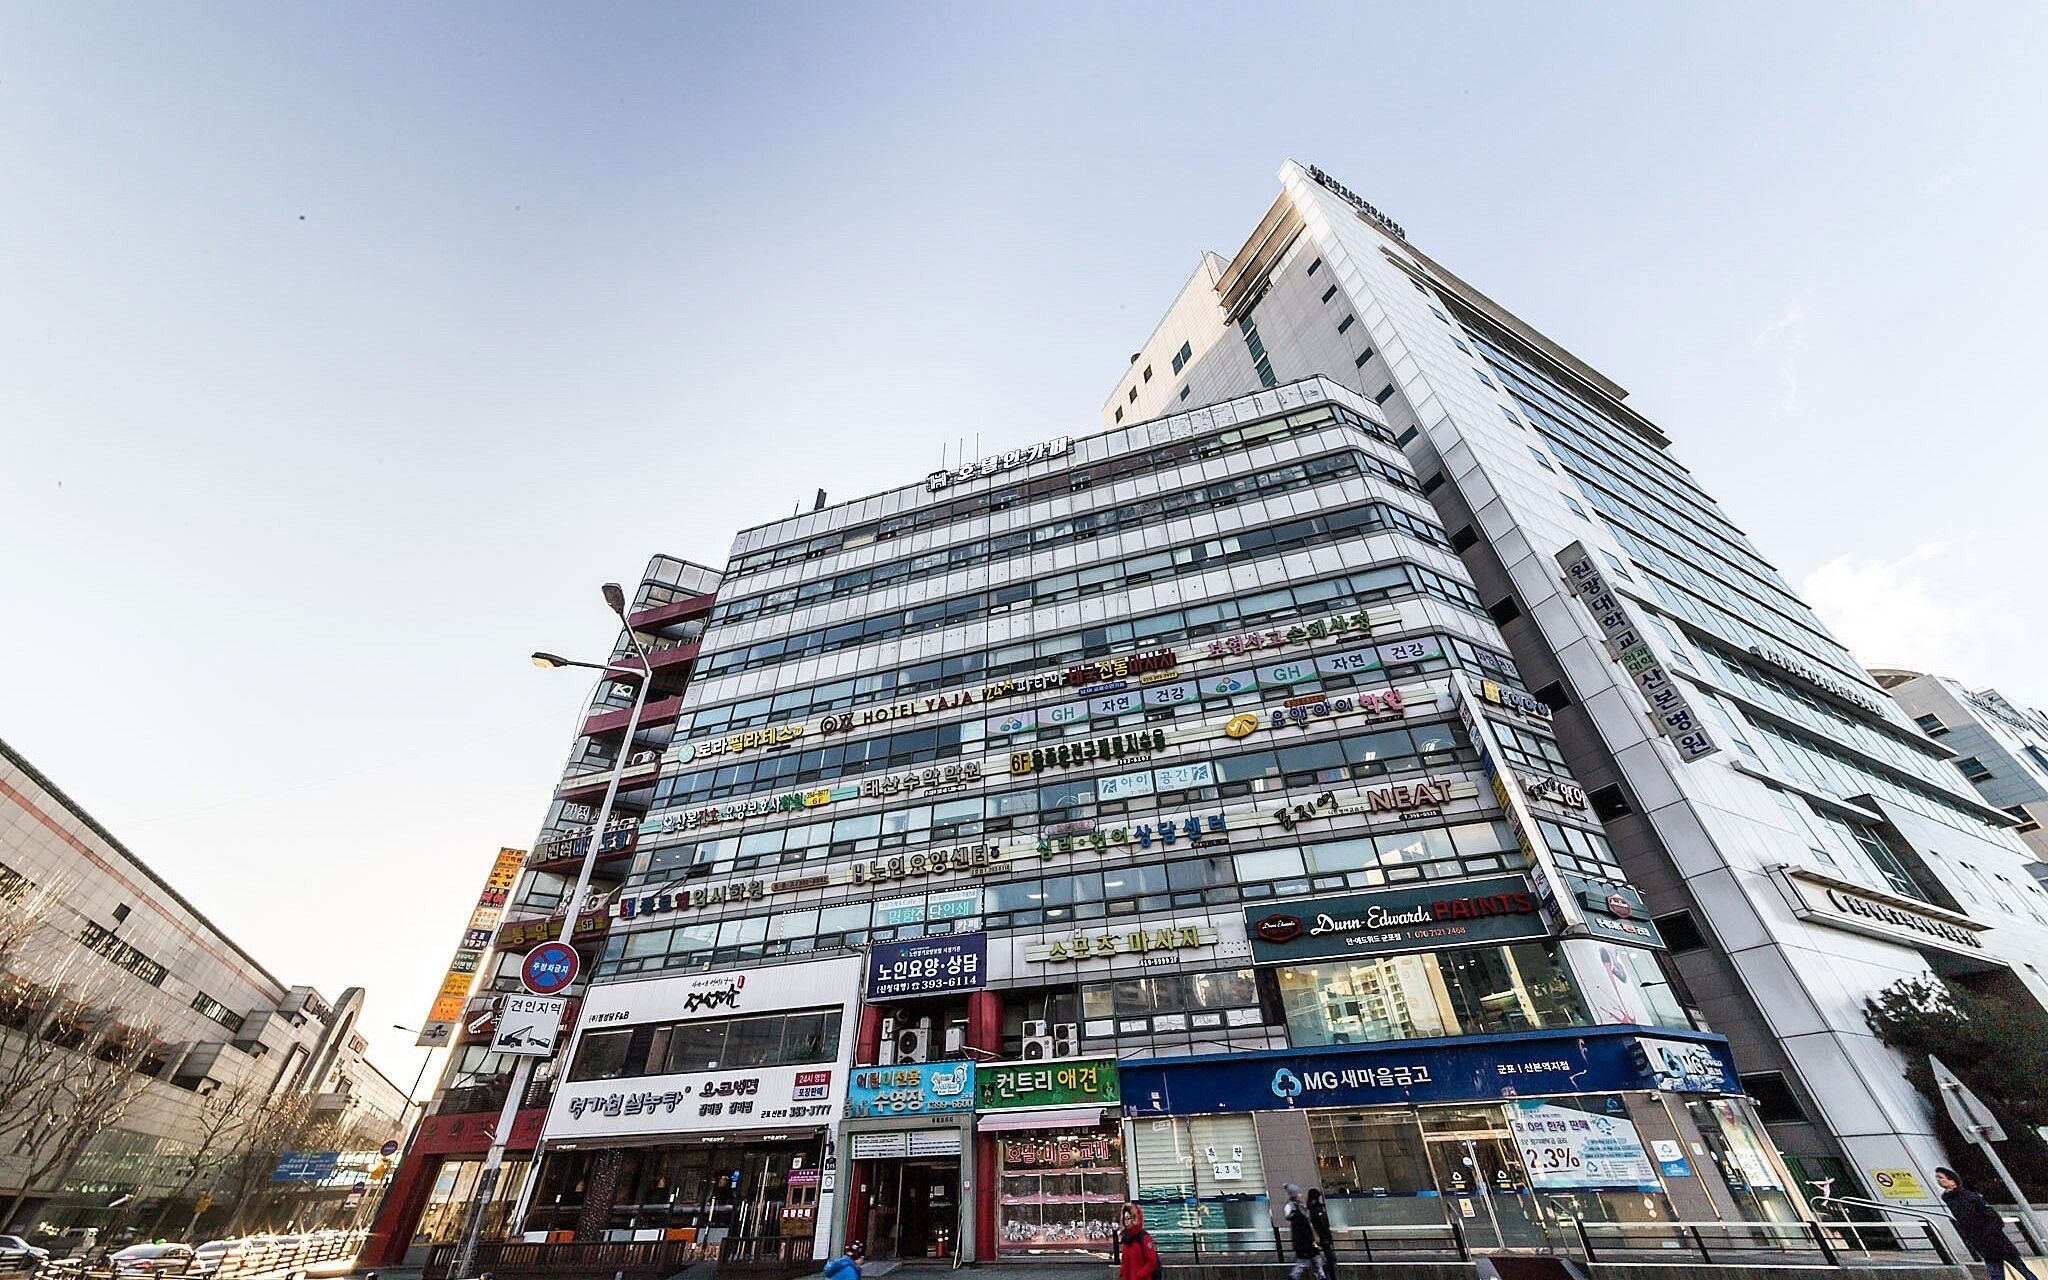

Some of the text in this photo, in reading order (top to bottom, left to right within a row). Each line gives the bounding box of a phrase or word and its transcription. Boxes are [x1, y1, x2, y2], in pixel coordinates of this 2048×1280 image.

[1571, 561, 1639, 651] 원광대학교
[1391, 643, 1424, 660] 건강
[1332, 653, 1365, 670] 자연
[1273, 666, 1301, 682] GH
[1102, 697, 1130, 712] 자연
[1156, 687, 1184, 703] 건강
[864, 702, 919, 725] HOTEL
[925, 692, 973, 711] YAJA
[1051, 707, 1075, 722] GH
[1641, 668, 1710, 756] 산본병원
[1012, 755, 1029, 771] 6F
[1121, 773, 1148, 792] 아이
[1159, 769, 1190, 785] 공간
[1367, 779, 1451, 814] NEAT
[870, 844, 989, 882] 노인요양센터
[1433, 891, 1533, 921] PAINTS
[921, 975, 977, 990] 393-6114
[510, 1000, 562, 1015] 견인지역
[1497, 1061, 1570, 1075] 군포 산본역지점
[997, 1067, 1099, 1098] 컨트리 애견
[1304, 1065, 1432, 1091] MG 새마을금고
[873, 1088, 926, 1112] 수영장
[1009, 1140, 1109, 1164] 호텔 미용 교배
[1526, 1147, 1581, 1170] 2.3%
